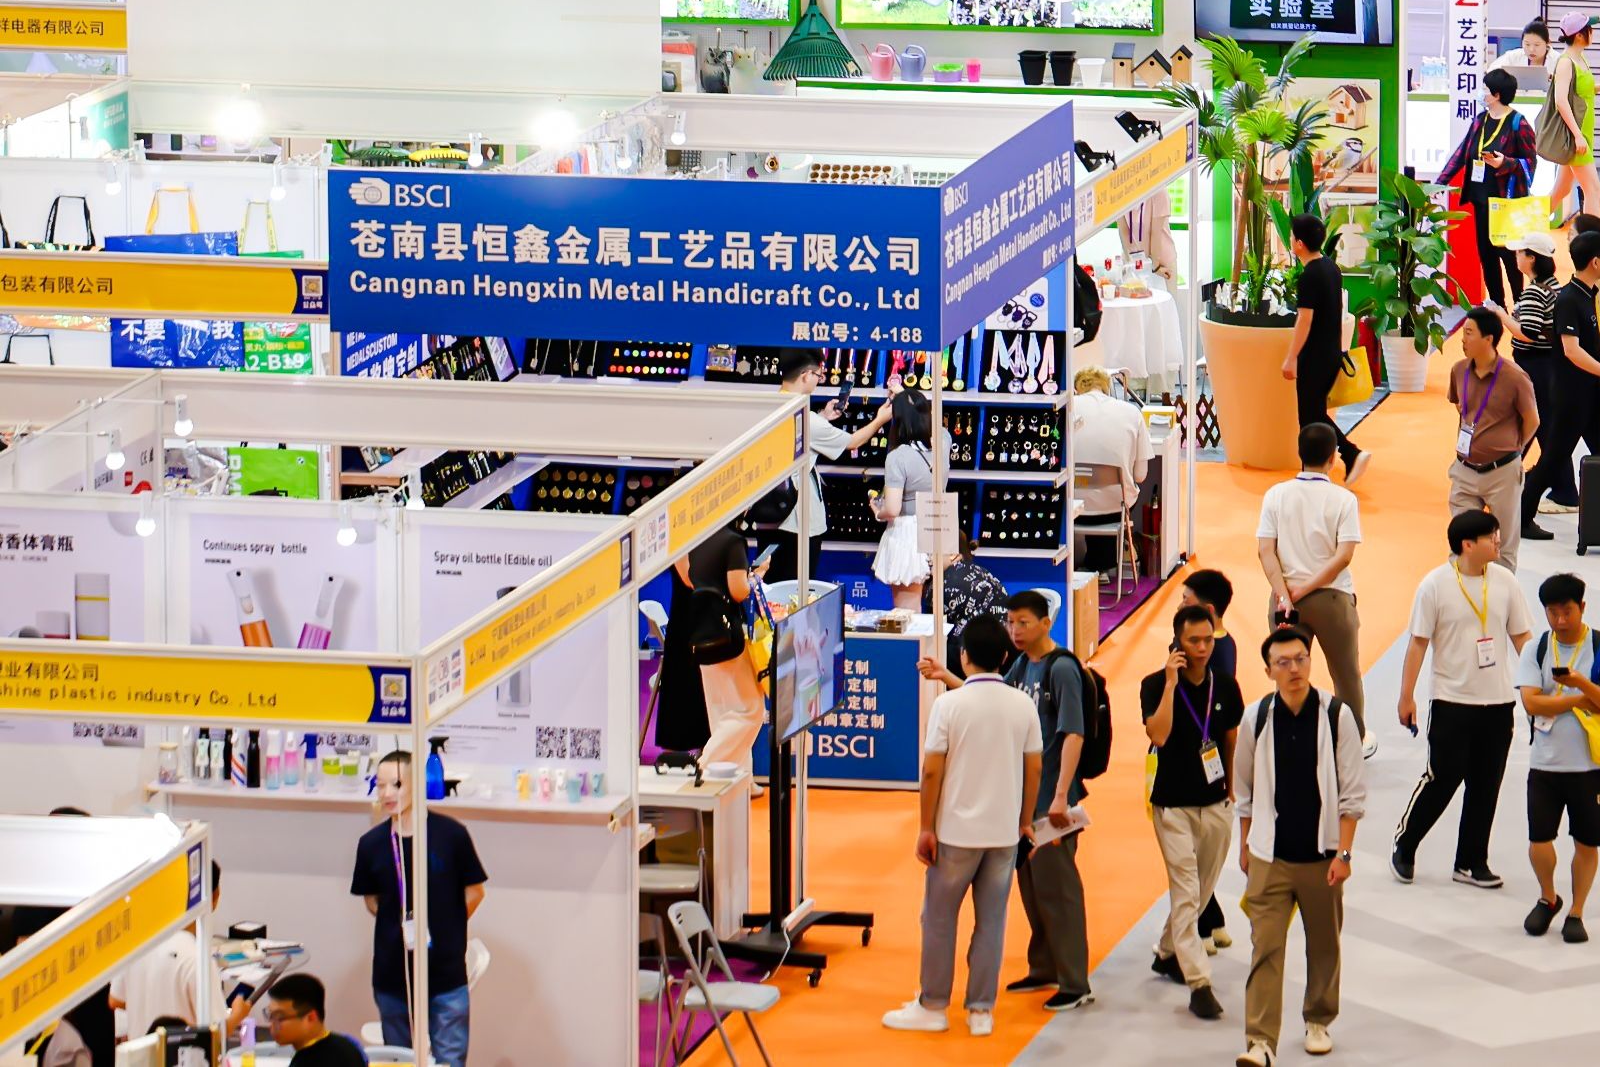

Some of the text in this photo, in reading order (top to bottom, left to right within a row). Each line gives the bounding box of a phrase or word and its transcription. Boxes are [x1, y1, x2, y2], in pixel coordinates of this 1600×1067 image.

[1456, 18, 1478, 121] 艺龙印刷
[395, 183, 451, 208] BSCI
[953, 186, 969, 214] BSCI
[944, 149, 1072, 273] 苍南县恒鑫金属工艺品有限公司
[999, 232, 1017, 265] Metal
[1017, 216, 1049, 255] Handicraft
[1060, 198, 1072, 223] Ltd
[349, 219, 922, 276] 苍南县恒鑫金属工艺品有限公司
[1, 274, 114, 296] 包装有限公司
[349, 270, 921, 313] Cangnan Hengxin Metal Handicraft Co., Ltd
[120, 318, 166, 342] 不要
[792, 320, 923, 344] 展位号： 4-188
[0, 532, 74, 552] 香体膏瓶
[203, 539, 308, 555] Continues spray bottle
[434, 551, 460, 565] Spray
[462, 552, 473, 564] oil
[475, 553, 502, 565] bottle
[49, 683, 117, 702] plastic
[126, 685, 201, 707] industry
[818, 734, 875, 759] BSCI
